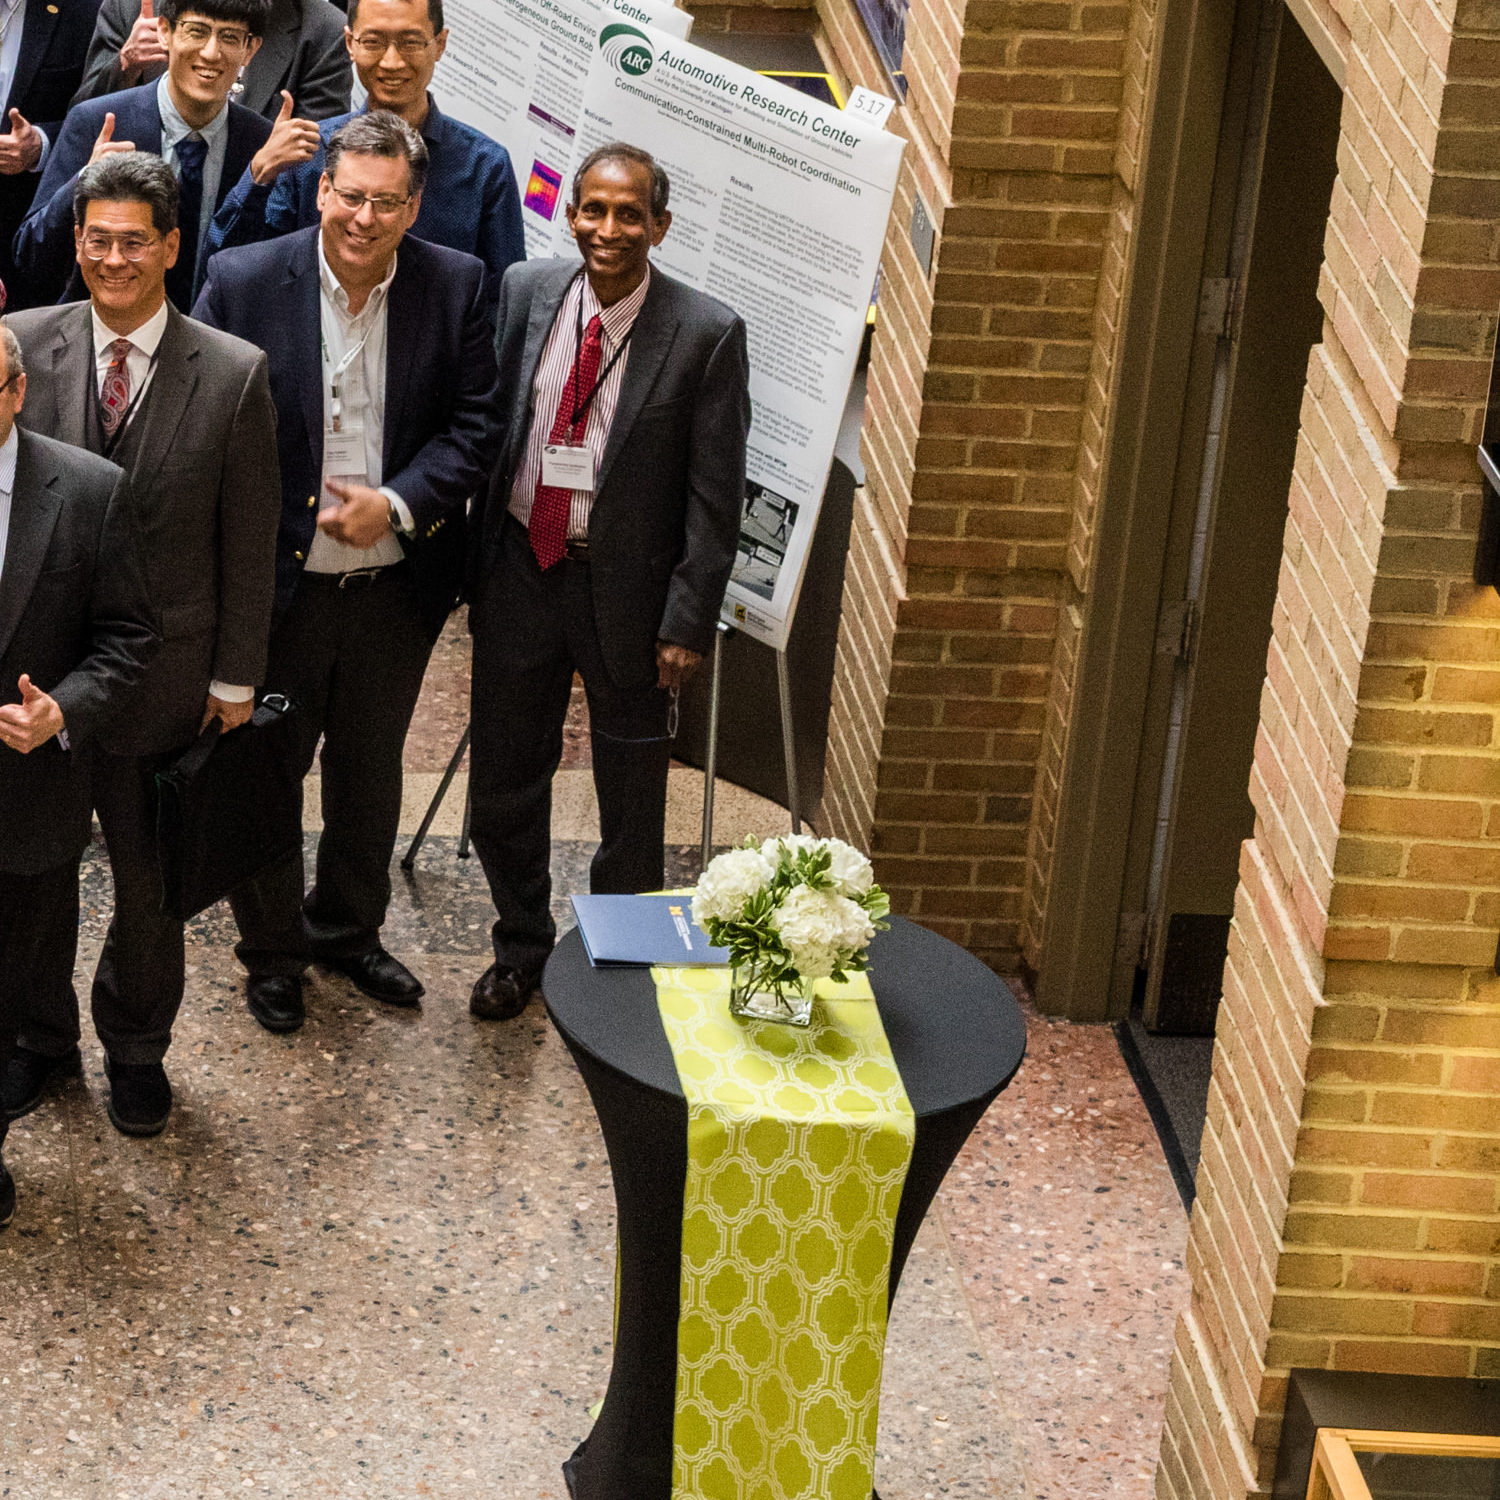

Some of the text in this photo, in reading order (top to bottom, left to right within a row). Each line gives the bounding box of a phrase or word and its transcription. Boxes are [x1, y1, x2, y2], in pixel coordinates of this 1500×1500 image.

[622, 50, 652, 74] ARC
[659, 50, 860, 147] Automotive Research Center
[854, 95, 885, 116] 5.17
[615, 77, 861, 195] Communication-Constrained Multi-Robot Coordination
